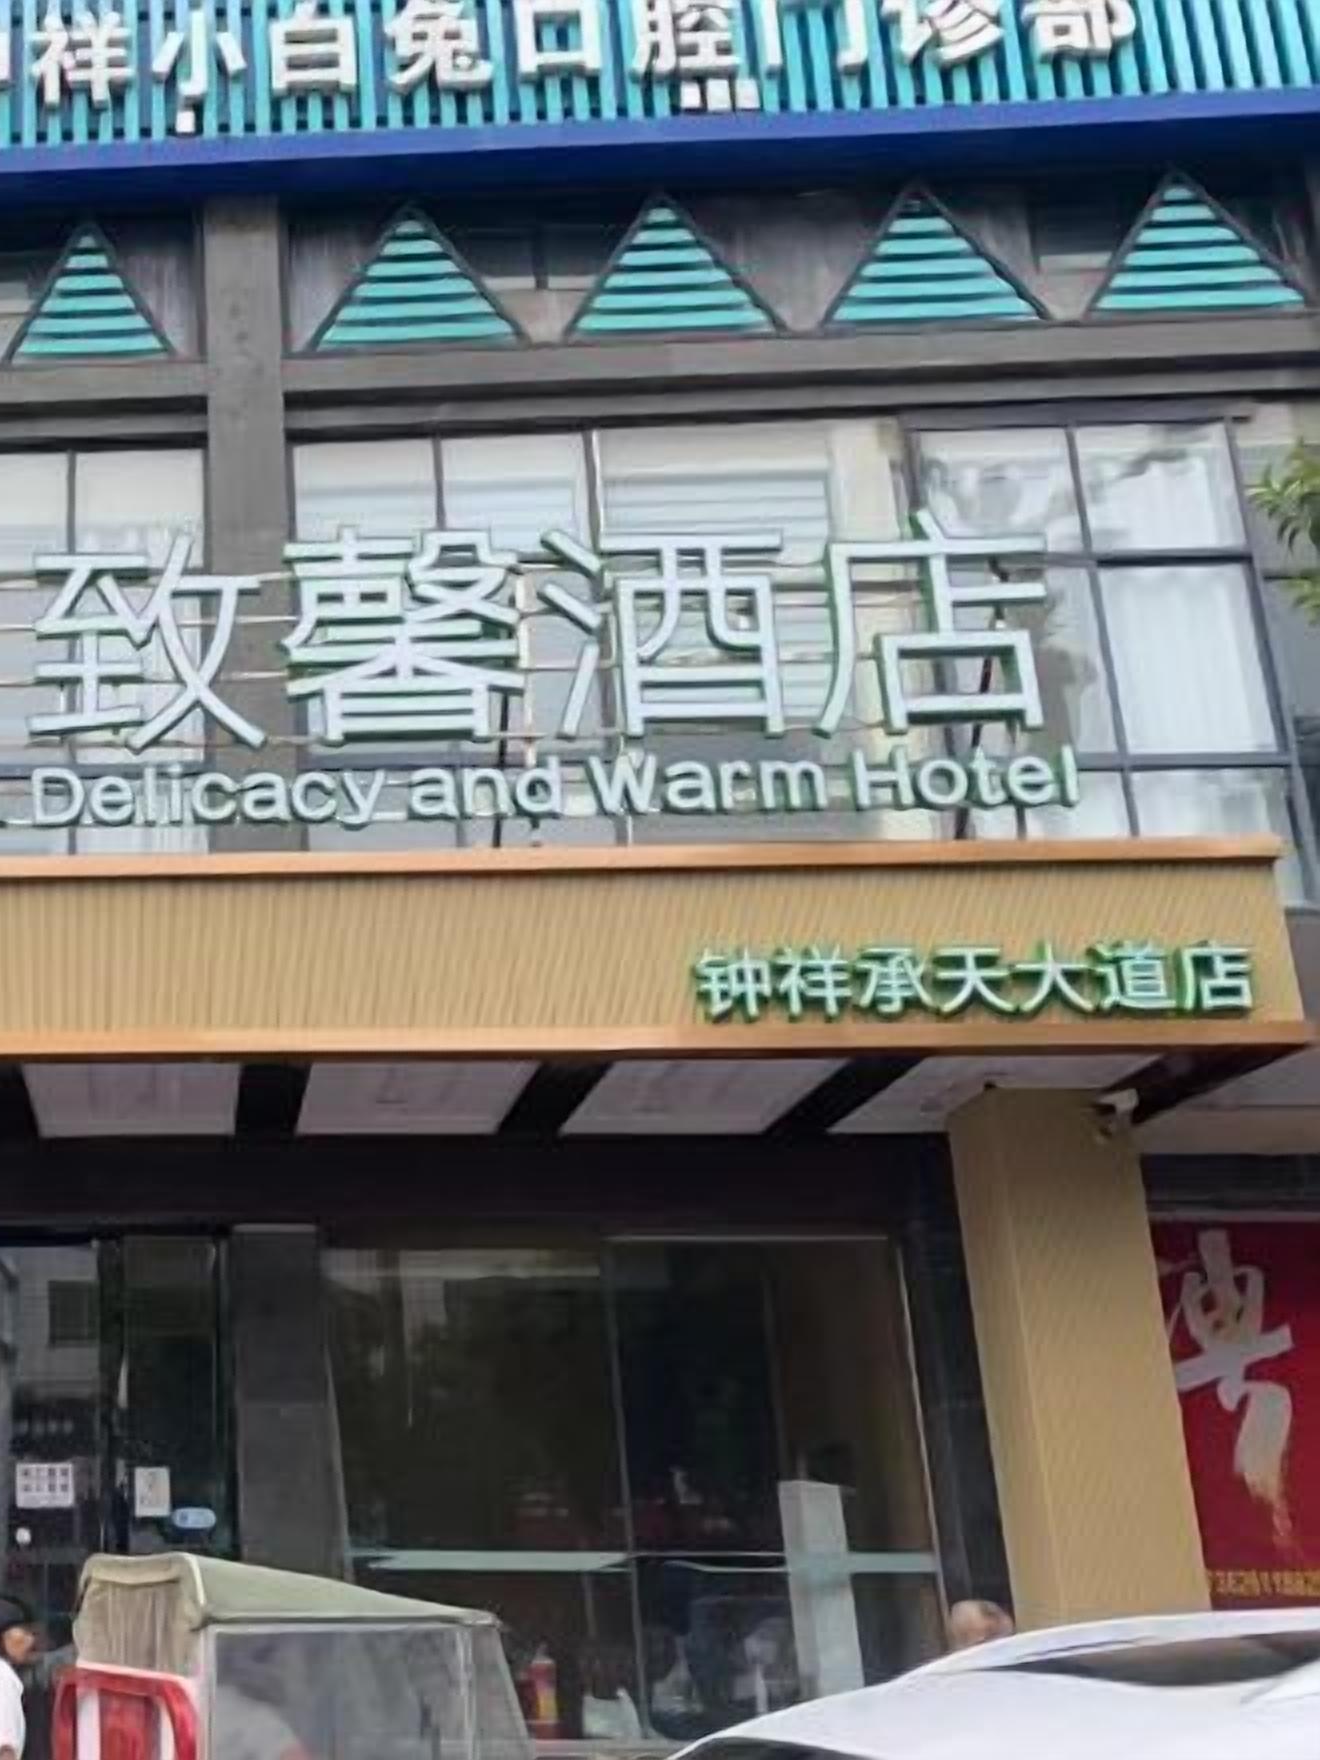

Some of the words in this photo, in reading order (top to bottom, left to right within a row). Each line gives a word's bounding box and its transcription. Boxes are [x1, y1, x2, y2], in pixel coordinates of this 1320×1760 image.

[26, 509, 1047, 753] 致馨酒店
[28, 763, 386, 830] Delicacy
[408, 756, 562, 818] and
[586, 749, 827, 815] Warm
[852, 744, 1080, 809] Hotel
[694, 940, 1254, 1022] 钟祥承天大道店
